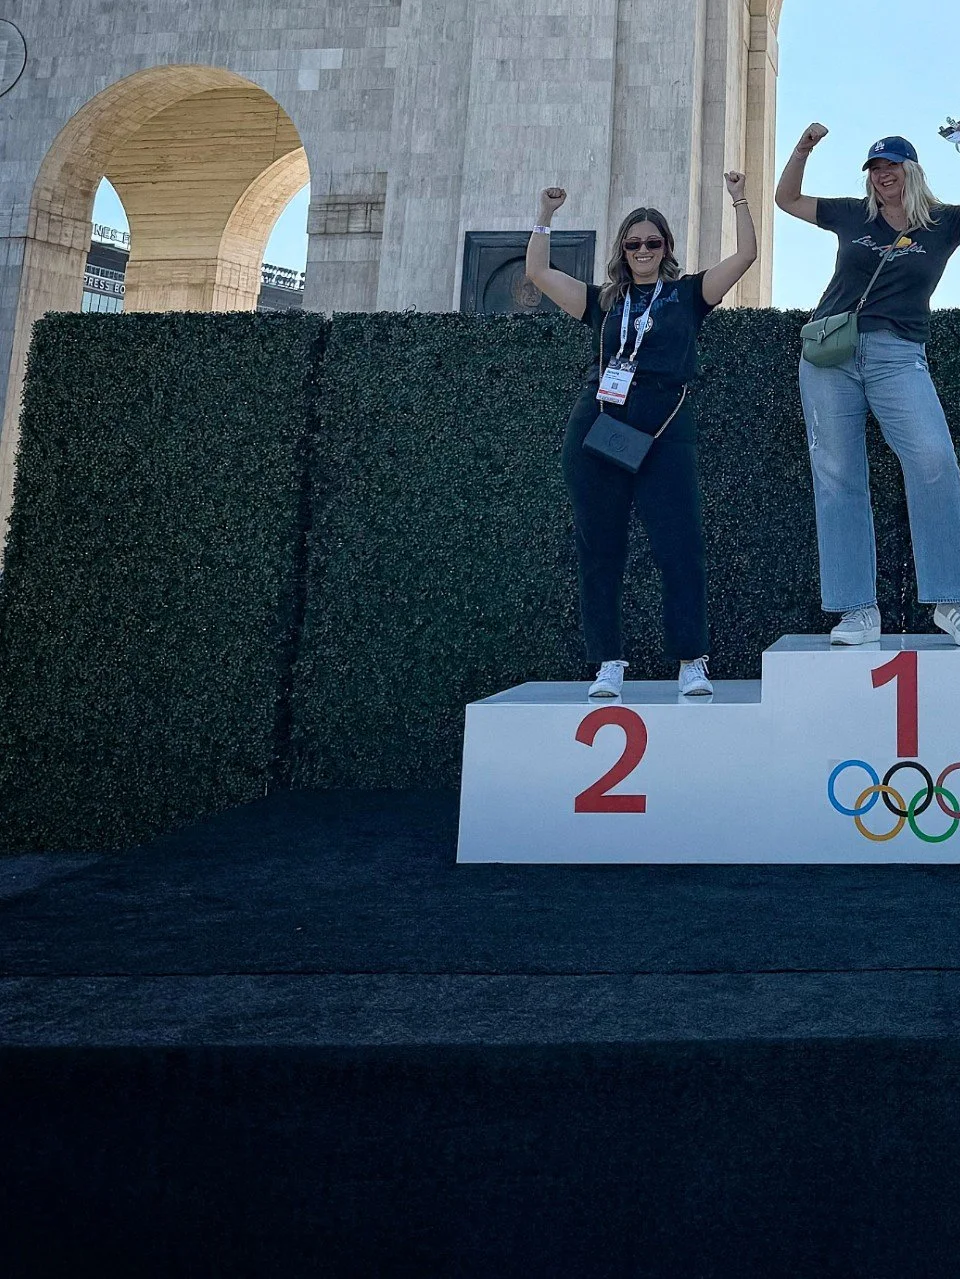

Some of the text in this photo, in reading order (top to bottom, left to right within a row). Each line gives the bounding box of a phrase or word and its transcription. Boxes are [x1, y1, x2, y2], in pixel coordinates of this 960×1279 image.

[874, 141, 885, 152] LA
[871, 241, 927, 261] Ageles
[870, 651, 918, 757] 1
[574, 706, 646, 813] 2
